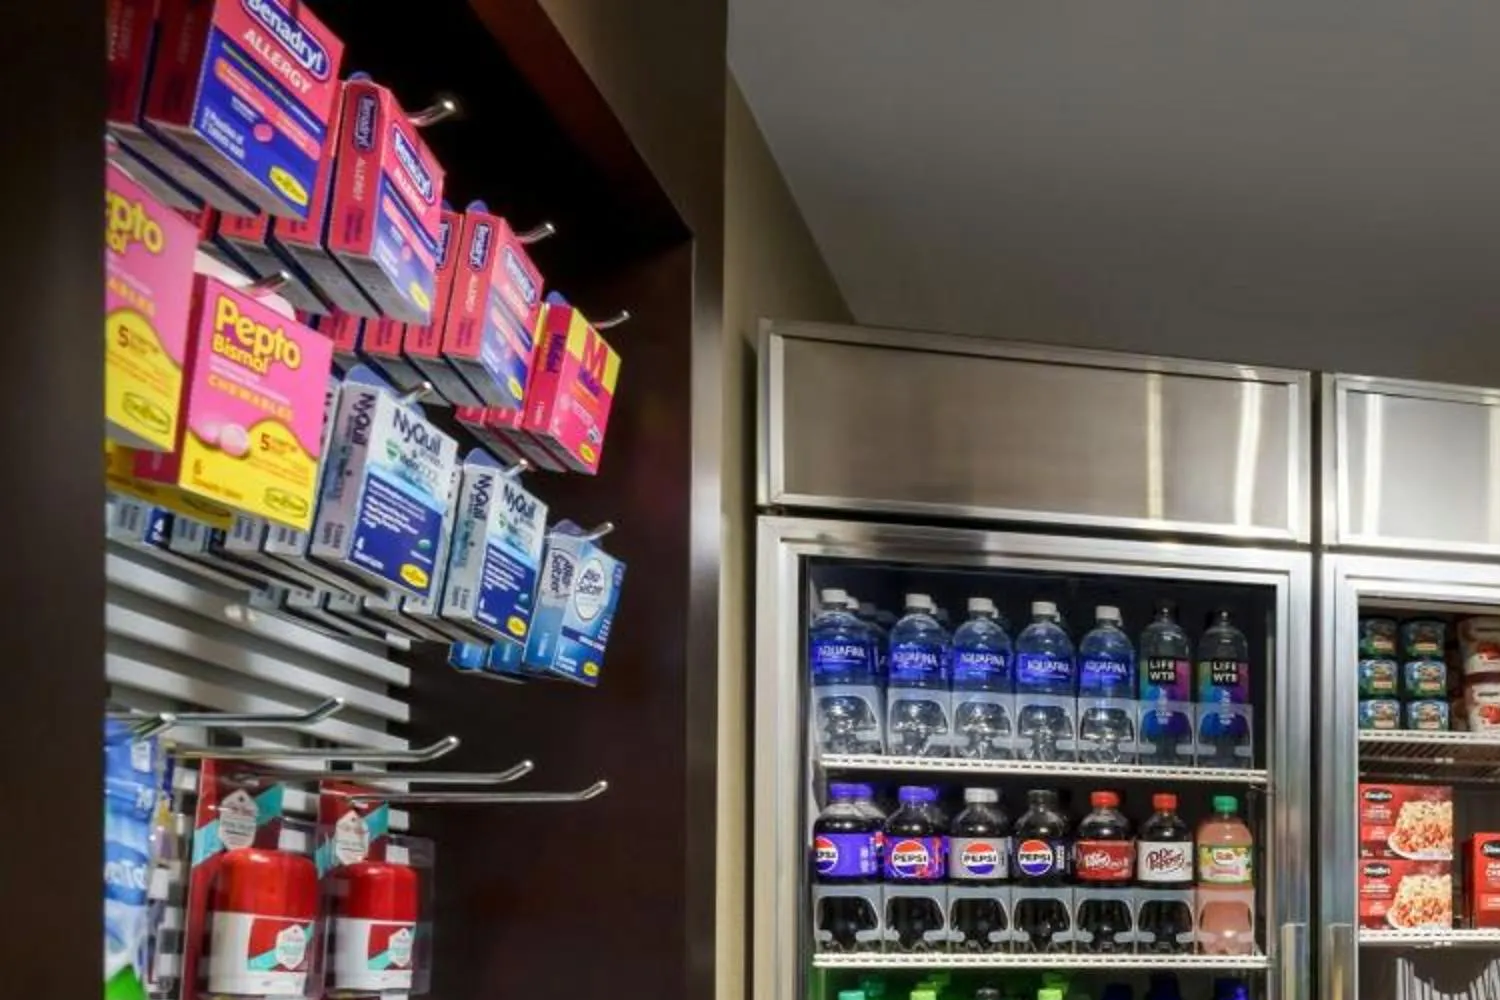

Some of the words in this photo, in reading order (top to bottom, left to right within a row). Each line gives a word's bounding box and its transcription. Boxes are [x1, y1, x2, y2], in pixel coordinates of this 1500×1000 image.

[242, 27, 313, 95] ALLERGY
[106, 191, 163, 253] pto
[214, 295, 302, 369] Pepto
[211, 332, 270, 375] Bismol
[392, 407, 442, 453] NyQuil
[1150, 661, 1175, 670] LIFE
[1213, 661, 1238, 671] LIFE
[1149, 672, 1175, 682] WTR
[893, 854, 928, 864] PEPSI
[963, 854, 998, 864] PEPSI
[1019, 852, 1053, 862] PEPSI
